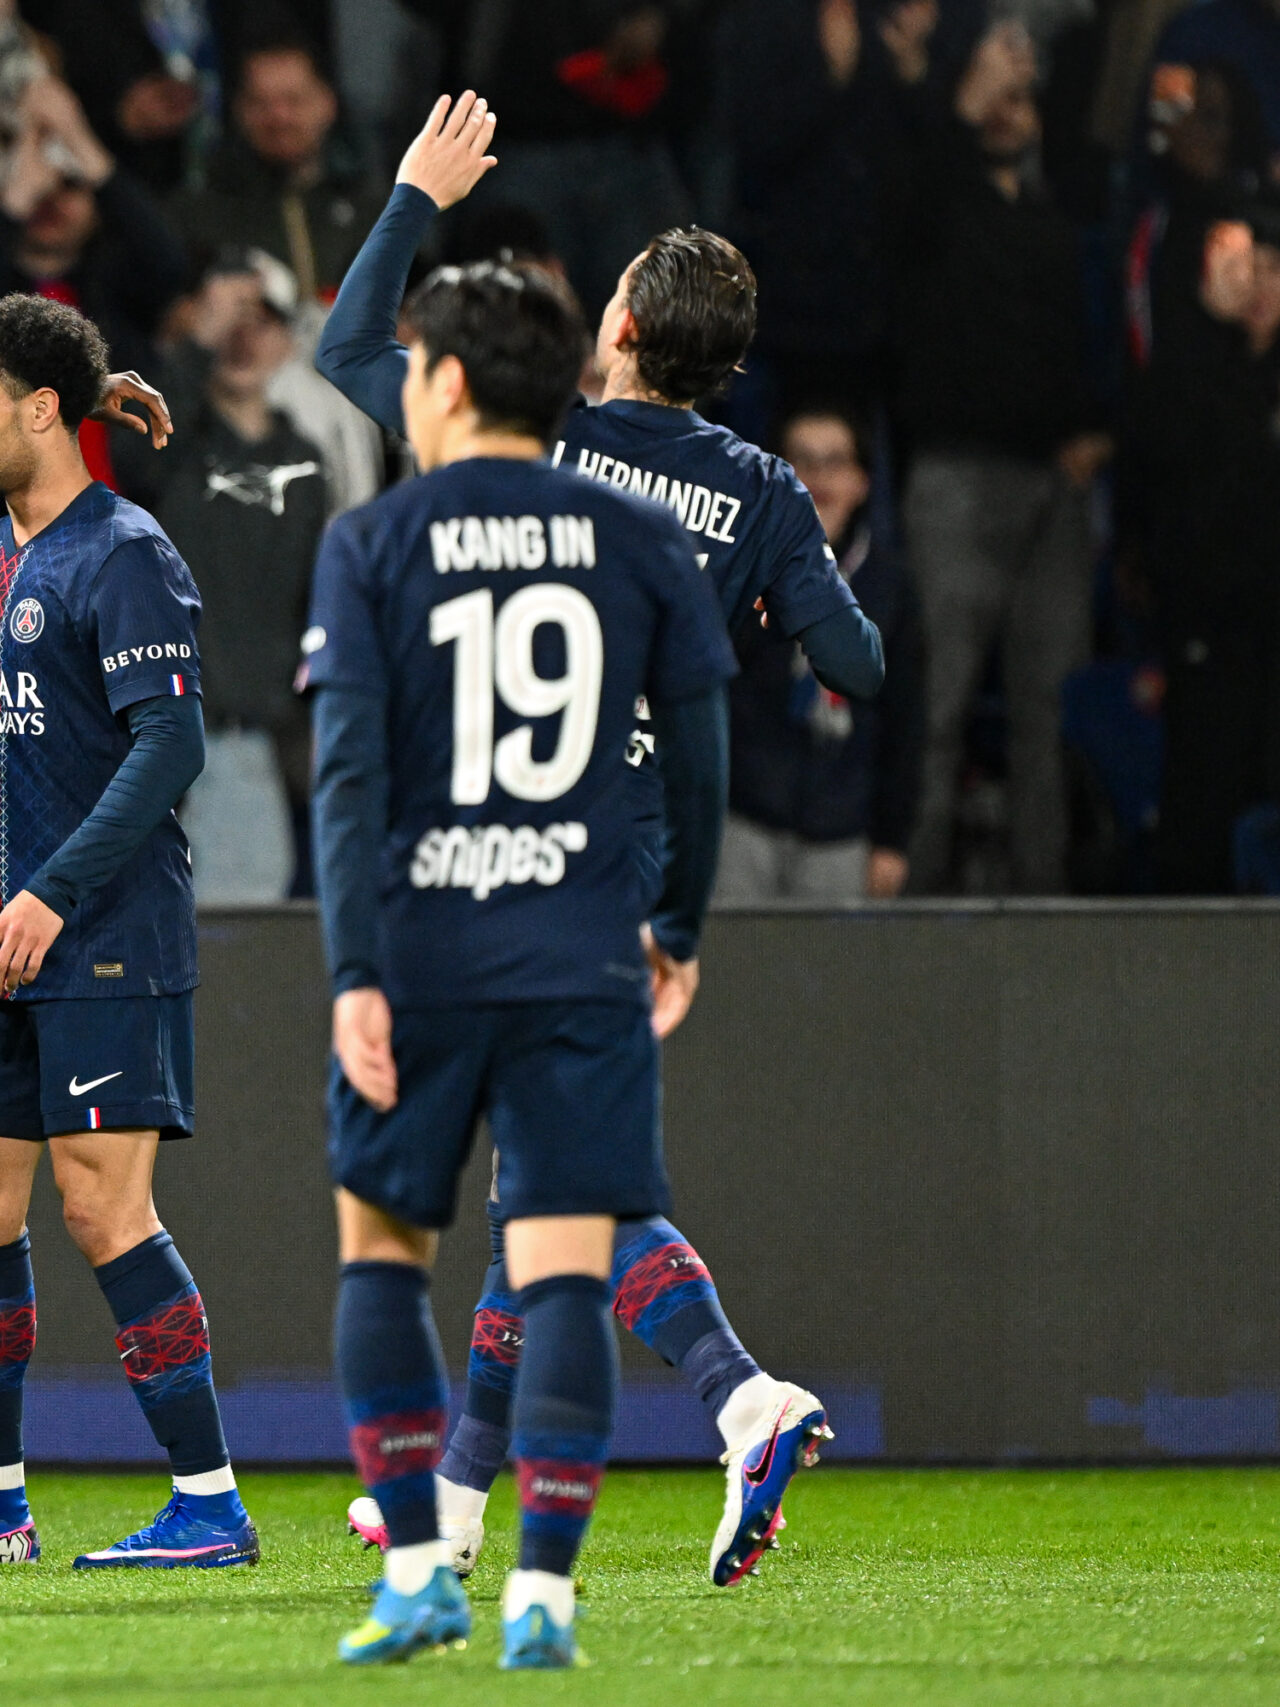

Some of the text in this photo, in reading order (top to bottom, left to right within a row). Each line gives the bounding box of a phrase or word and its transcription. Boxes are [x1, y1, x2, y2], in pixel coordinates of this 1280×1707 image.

[576, 448, 742, 544] HERNANDEZ
[429, 514, 596, 574] KANG IN
[102, 643, 192, 673] BEYOND
[429, 582, 604, 805] 19
[409, 823, 566, 901] snipes
